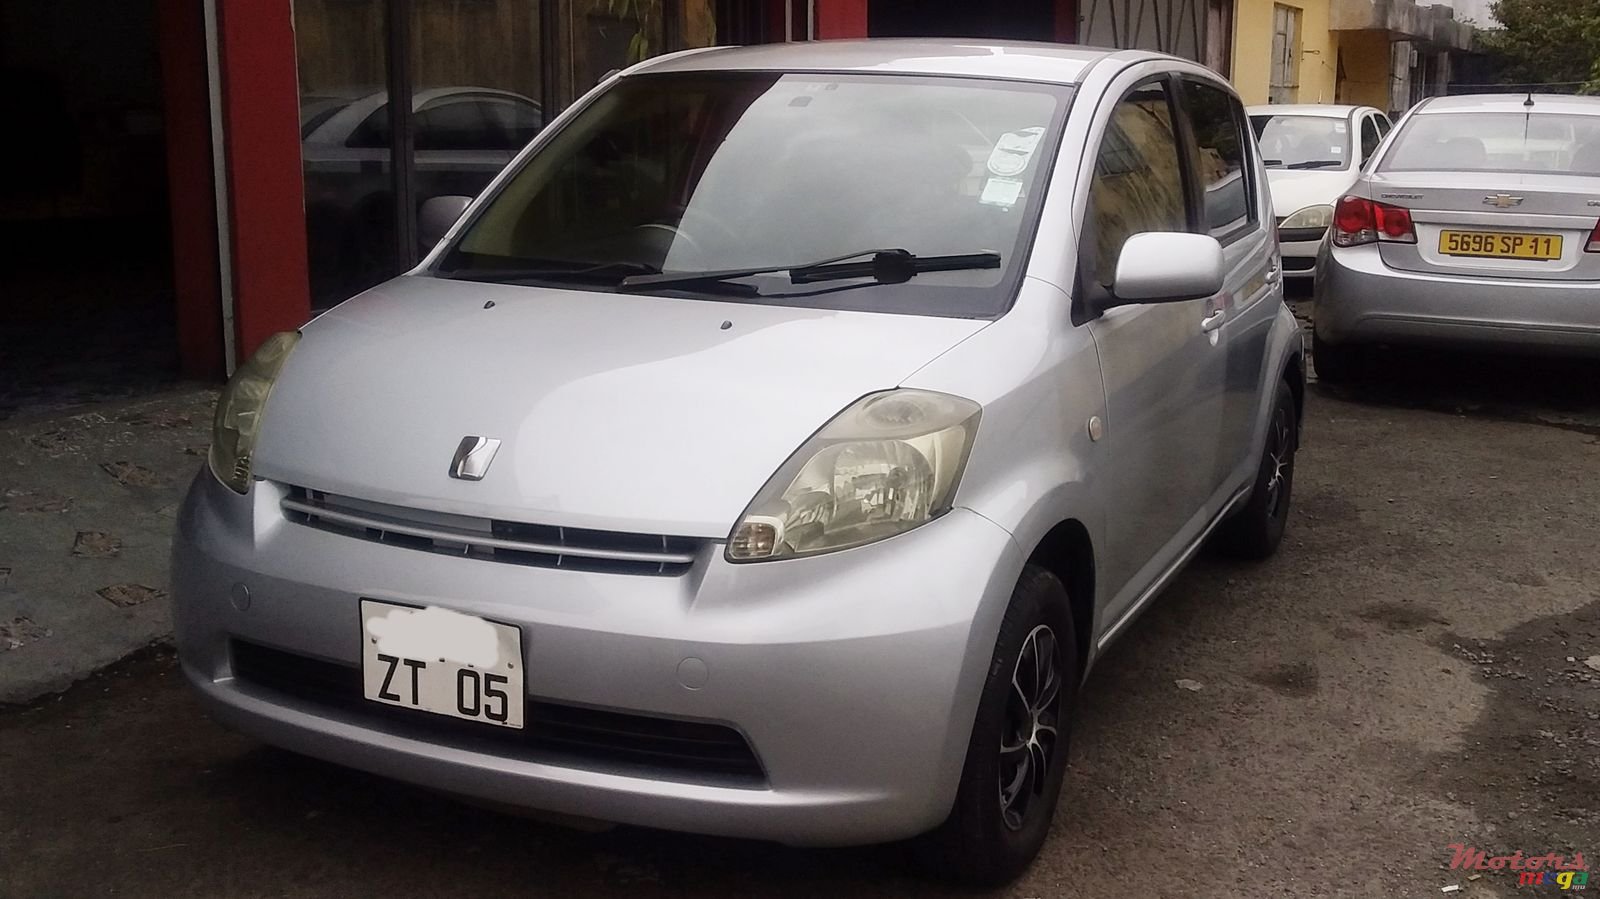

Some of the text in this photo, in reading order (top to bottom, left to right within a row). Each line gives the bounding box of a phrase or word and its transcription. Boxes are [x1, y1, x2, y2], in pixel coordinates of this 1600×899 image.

[1448, 233, 1494, 252] 5696
[1500, 236, 1523, 254] SP
[377, 653, 508, 722] ZT 05
